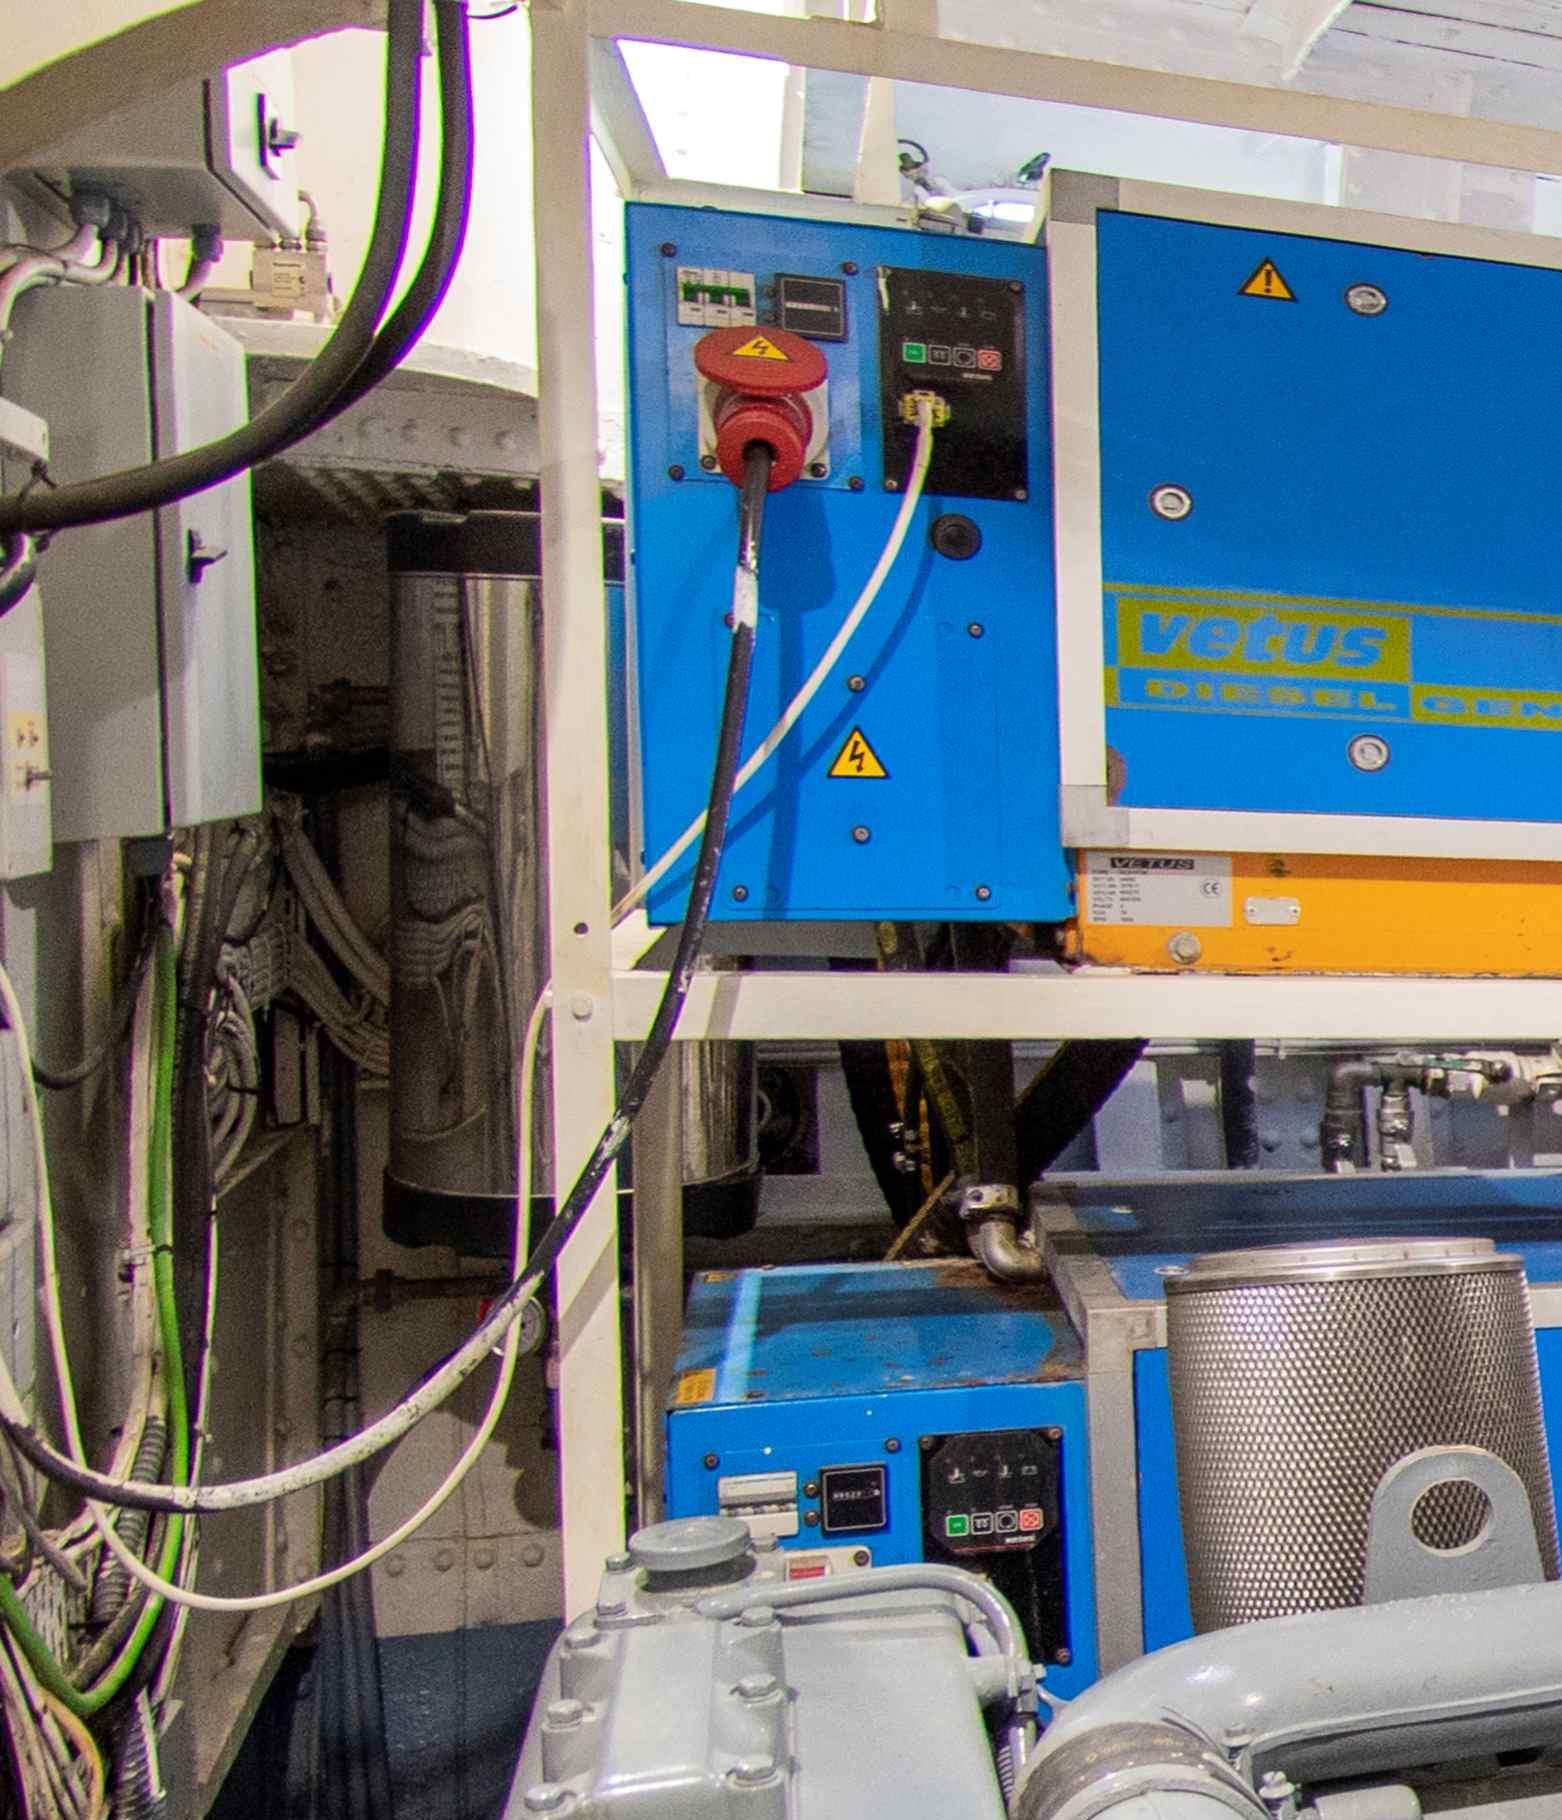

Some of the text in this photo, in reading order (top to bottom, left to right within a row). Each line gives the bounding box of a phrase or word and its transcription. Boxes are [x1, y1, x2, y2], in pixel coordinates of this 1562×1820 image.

[1139, 611, 1388, 668] vetus
[1145, 679, 1397, 711] DIESEL
[1110, 857, 1195, 870] VETUS
